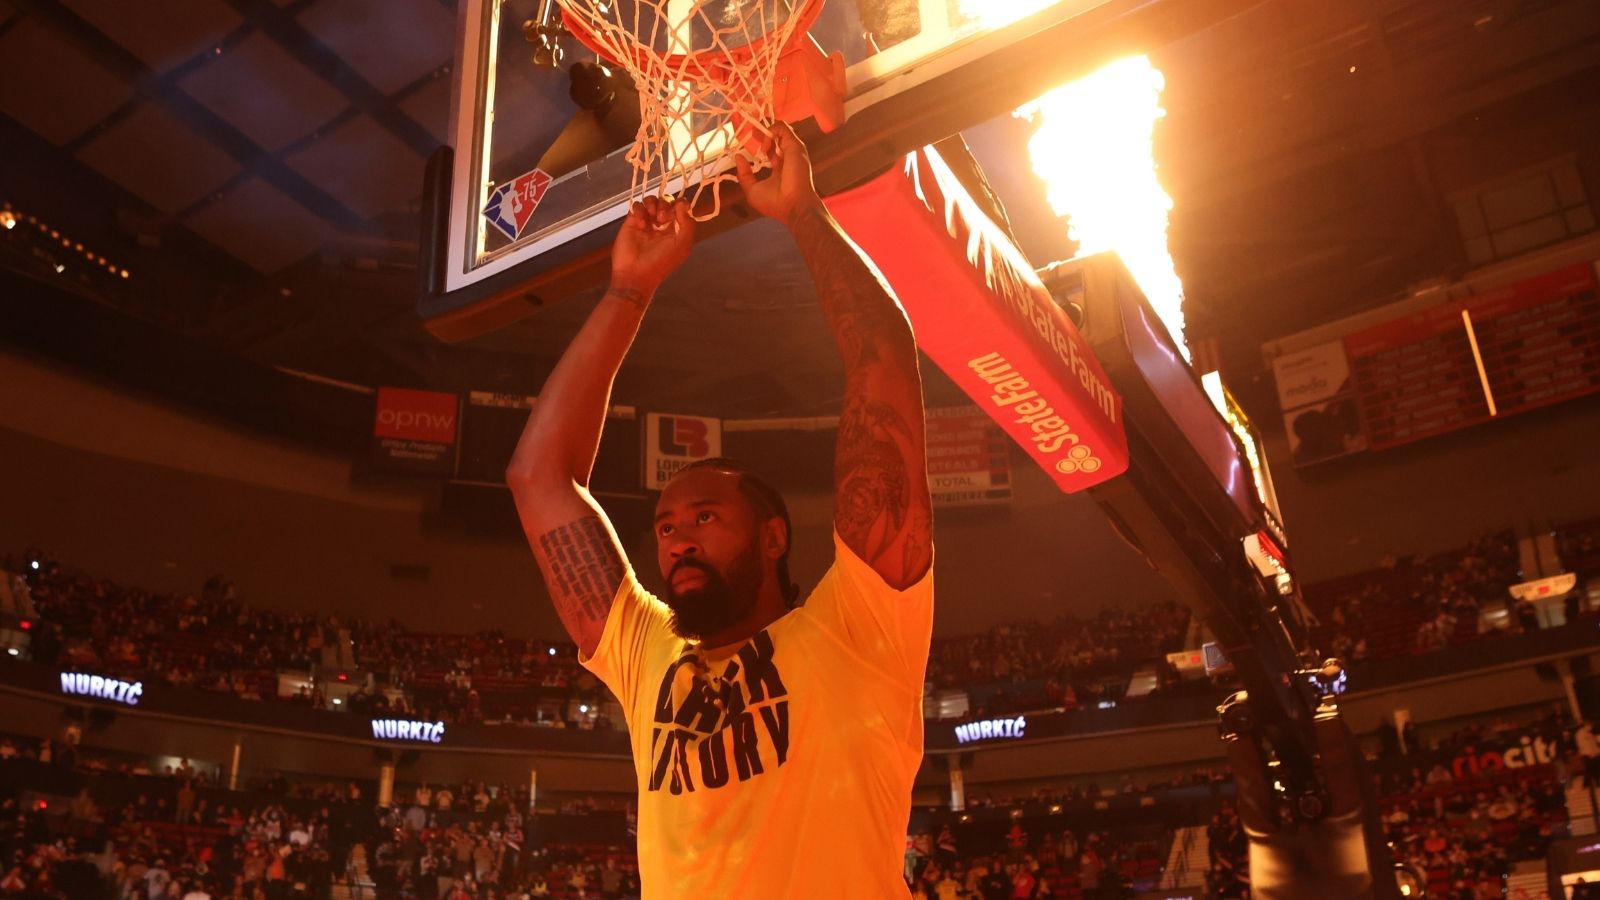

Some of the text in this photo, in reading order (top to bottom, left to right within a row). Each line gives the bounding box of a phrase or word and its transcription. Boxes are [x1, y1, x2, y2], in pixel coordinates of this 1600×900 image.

[523, 180, 537, 201] 75
[378, 408, 453, 430] opnw
[934, 476, 975, 487] TOTAL
[60, 672, 143, 705] NURKIĆ
[371, 719, 445, 743] NURKIĆ
[954, 715, 1026, 743] NURKIĆ
